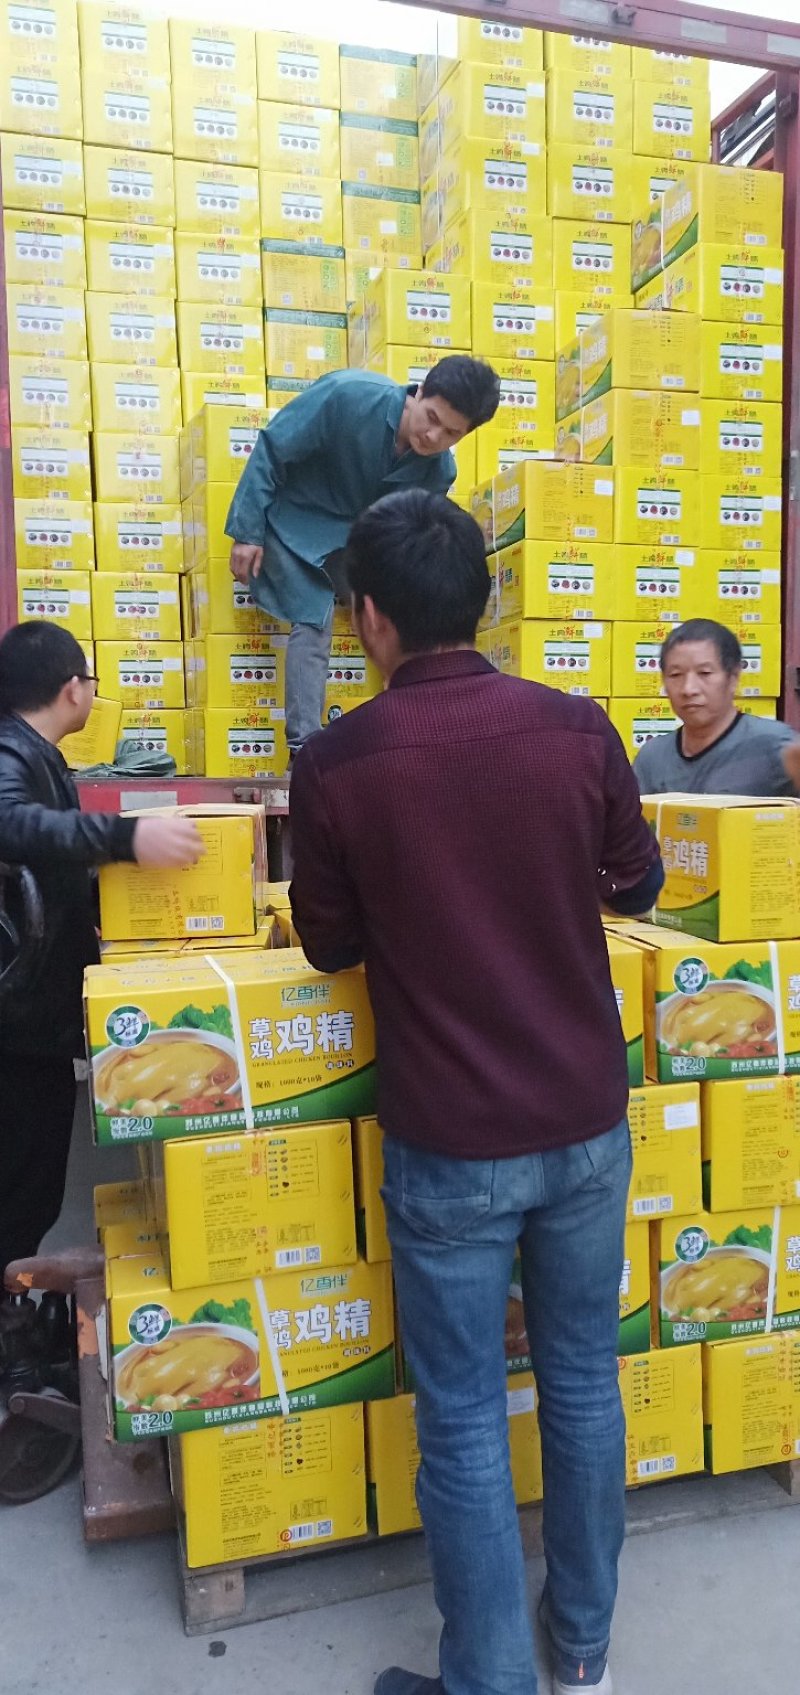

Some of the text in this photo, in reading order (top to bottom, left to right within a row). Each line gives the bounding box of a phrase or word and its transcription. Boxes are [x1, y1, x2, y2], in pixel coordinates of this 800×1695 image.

[673, 838, 710, 878] 鸡精
[274, 1010, 356, 1057] 鸡精
[128, 1116, 153, 1132] 2.0
[300, 1273, 348, 1293] 亿香伴
[294, 1298, 372, 1345] 鸡精
[311, 1343, 339, 1352] CHICKEN
[148, 1410, 173, 1429] 2.0
